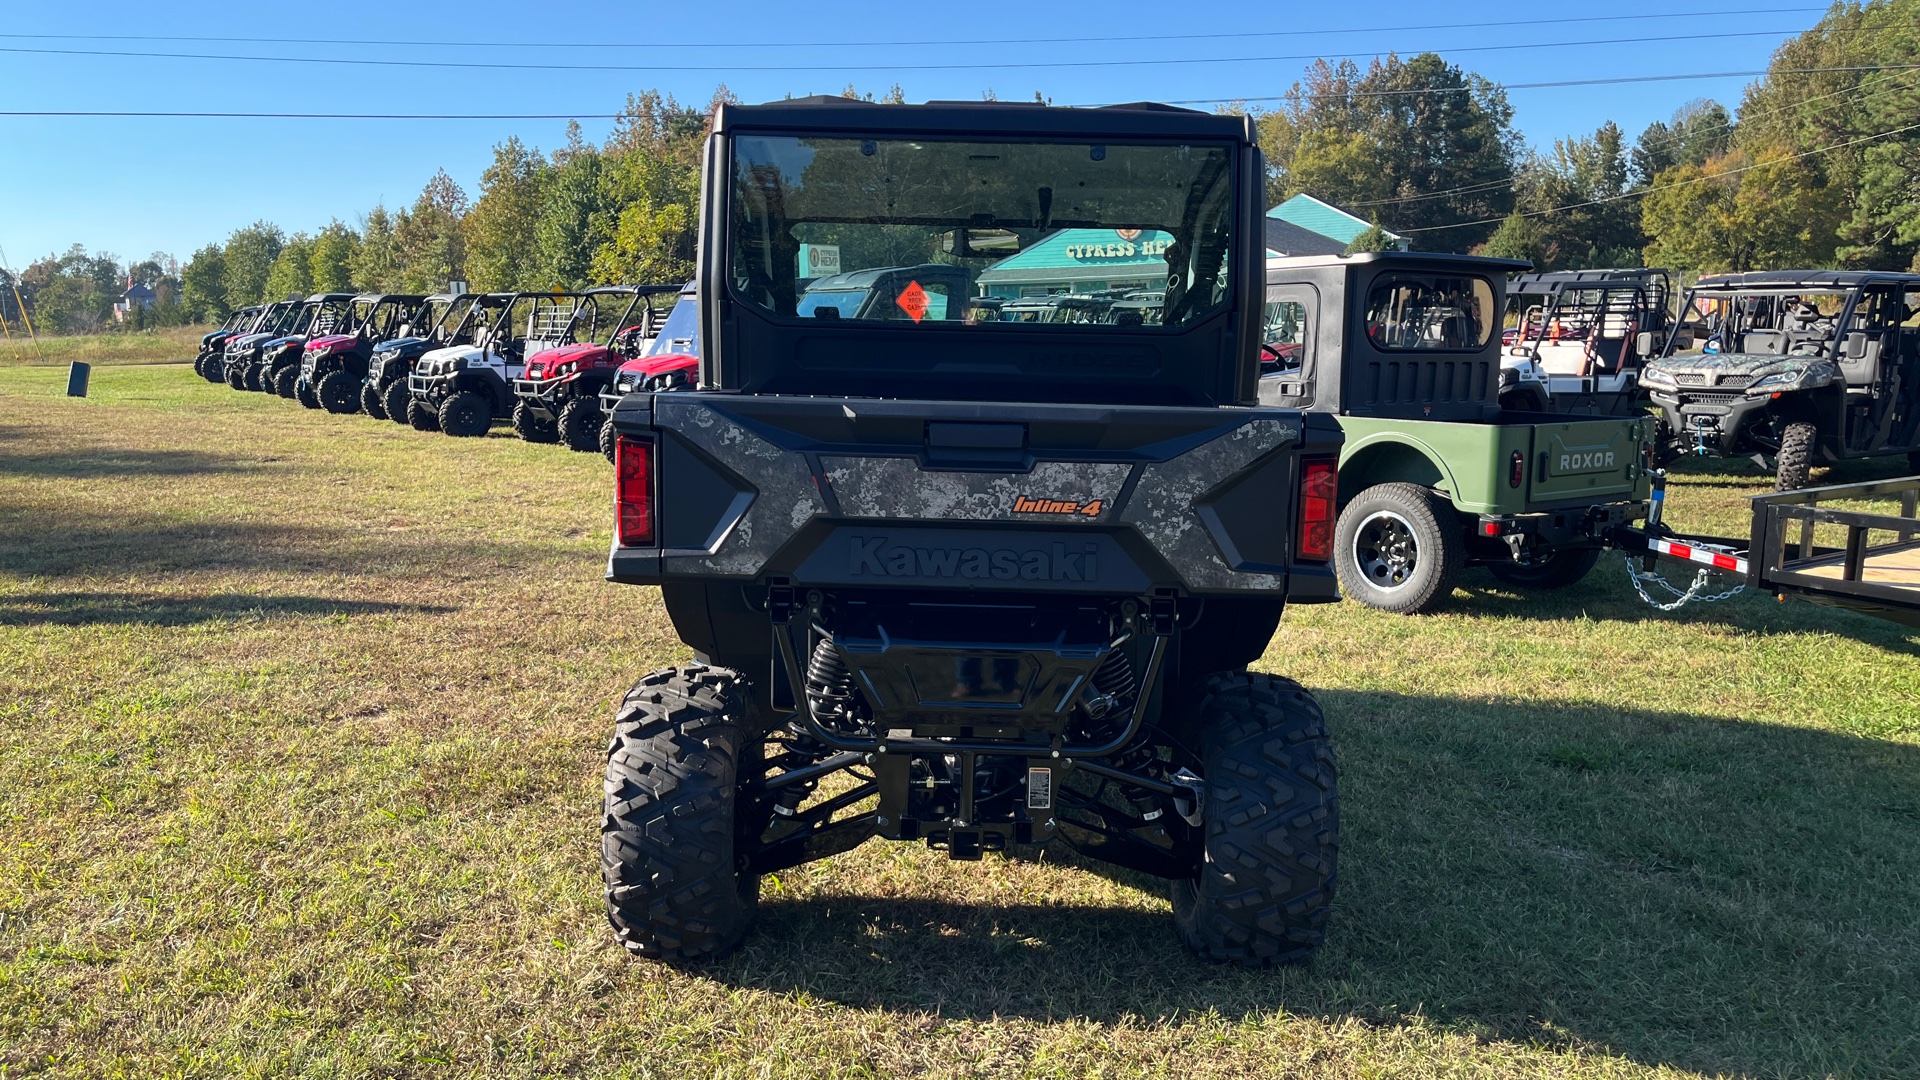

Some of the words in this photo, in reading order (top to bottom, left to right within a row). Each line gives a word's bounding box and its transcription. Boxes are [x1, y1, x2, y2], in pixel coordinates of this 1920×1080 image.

[1066, 242, 1135, 258] CYPRESS
[1142, 239, 1175, 255] HE
[820, 256, 839, 267] HEMP
[1560, 451, 1614, 470] ROXOR
[1012, 495, 1102, 516] Inline-4
[850, 535, 1098, 581] Kawasaki
